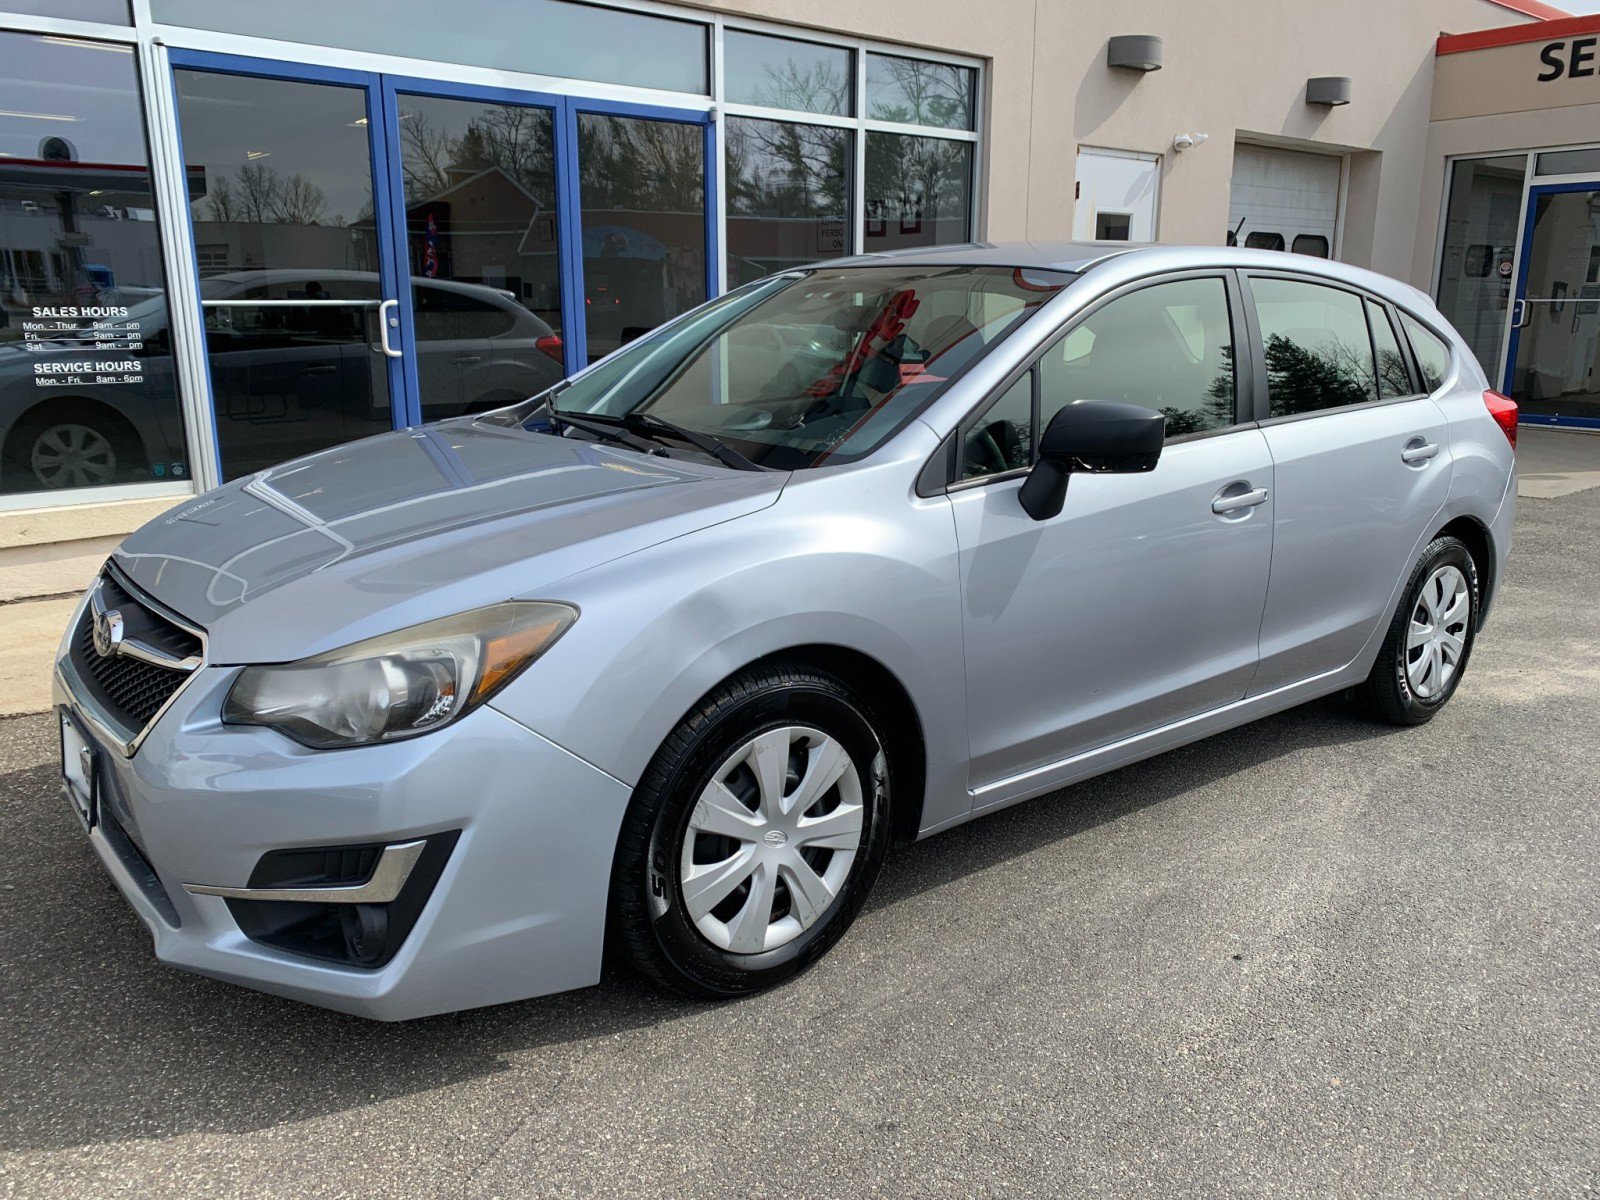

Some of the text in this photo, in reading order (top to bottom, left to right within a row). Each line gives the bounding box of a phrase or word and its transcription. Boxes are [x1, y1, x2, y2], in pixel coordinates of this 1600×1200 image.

[1537, 38, 1600, 82] SE
[821, 228, 844, 237] PERSO
[32, 306, 128, 317] SALES HOURS
[22, 322, 47, 330] Mon.
[55, 321, 79, 330] Thur.
[92, 321, 113, 330] 9am
[126, 322, 140, 330] pm
[93, 331, 114, 340] 9am
[127, 332, 141, 340] pm
[26, 342, 45, 350] Sat.
[95, 341, 115, 350] 9am
[129, 342, 143, 350] pm
[33, 361, 142, 373] SERVICE HOURS
[35, 377, 59, 386] Mon.
[96, 375, 116, 383] 8am
